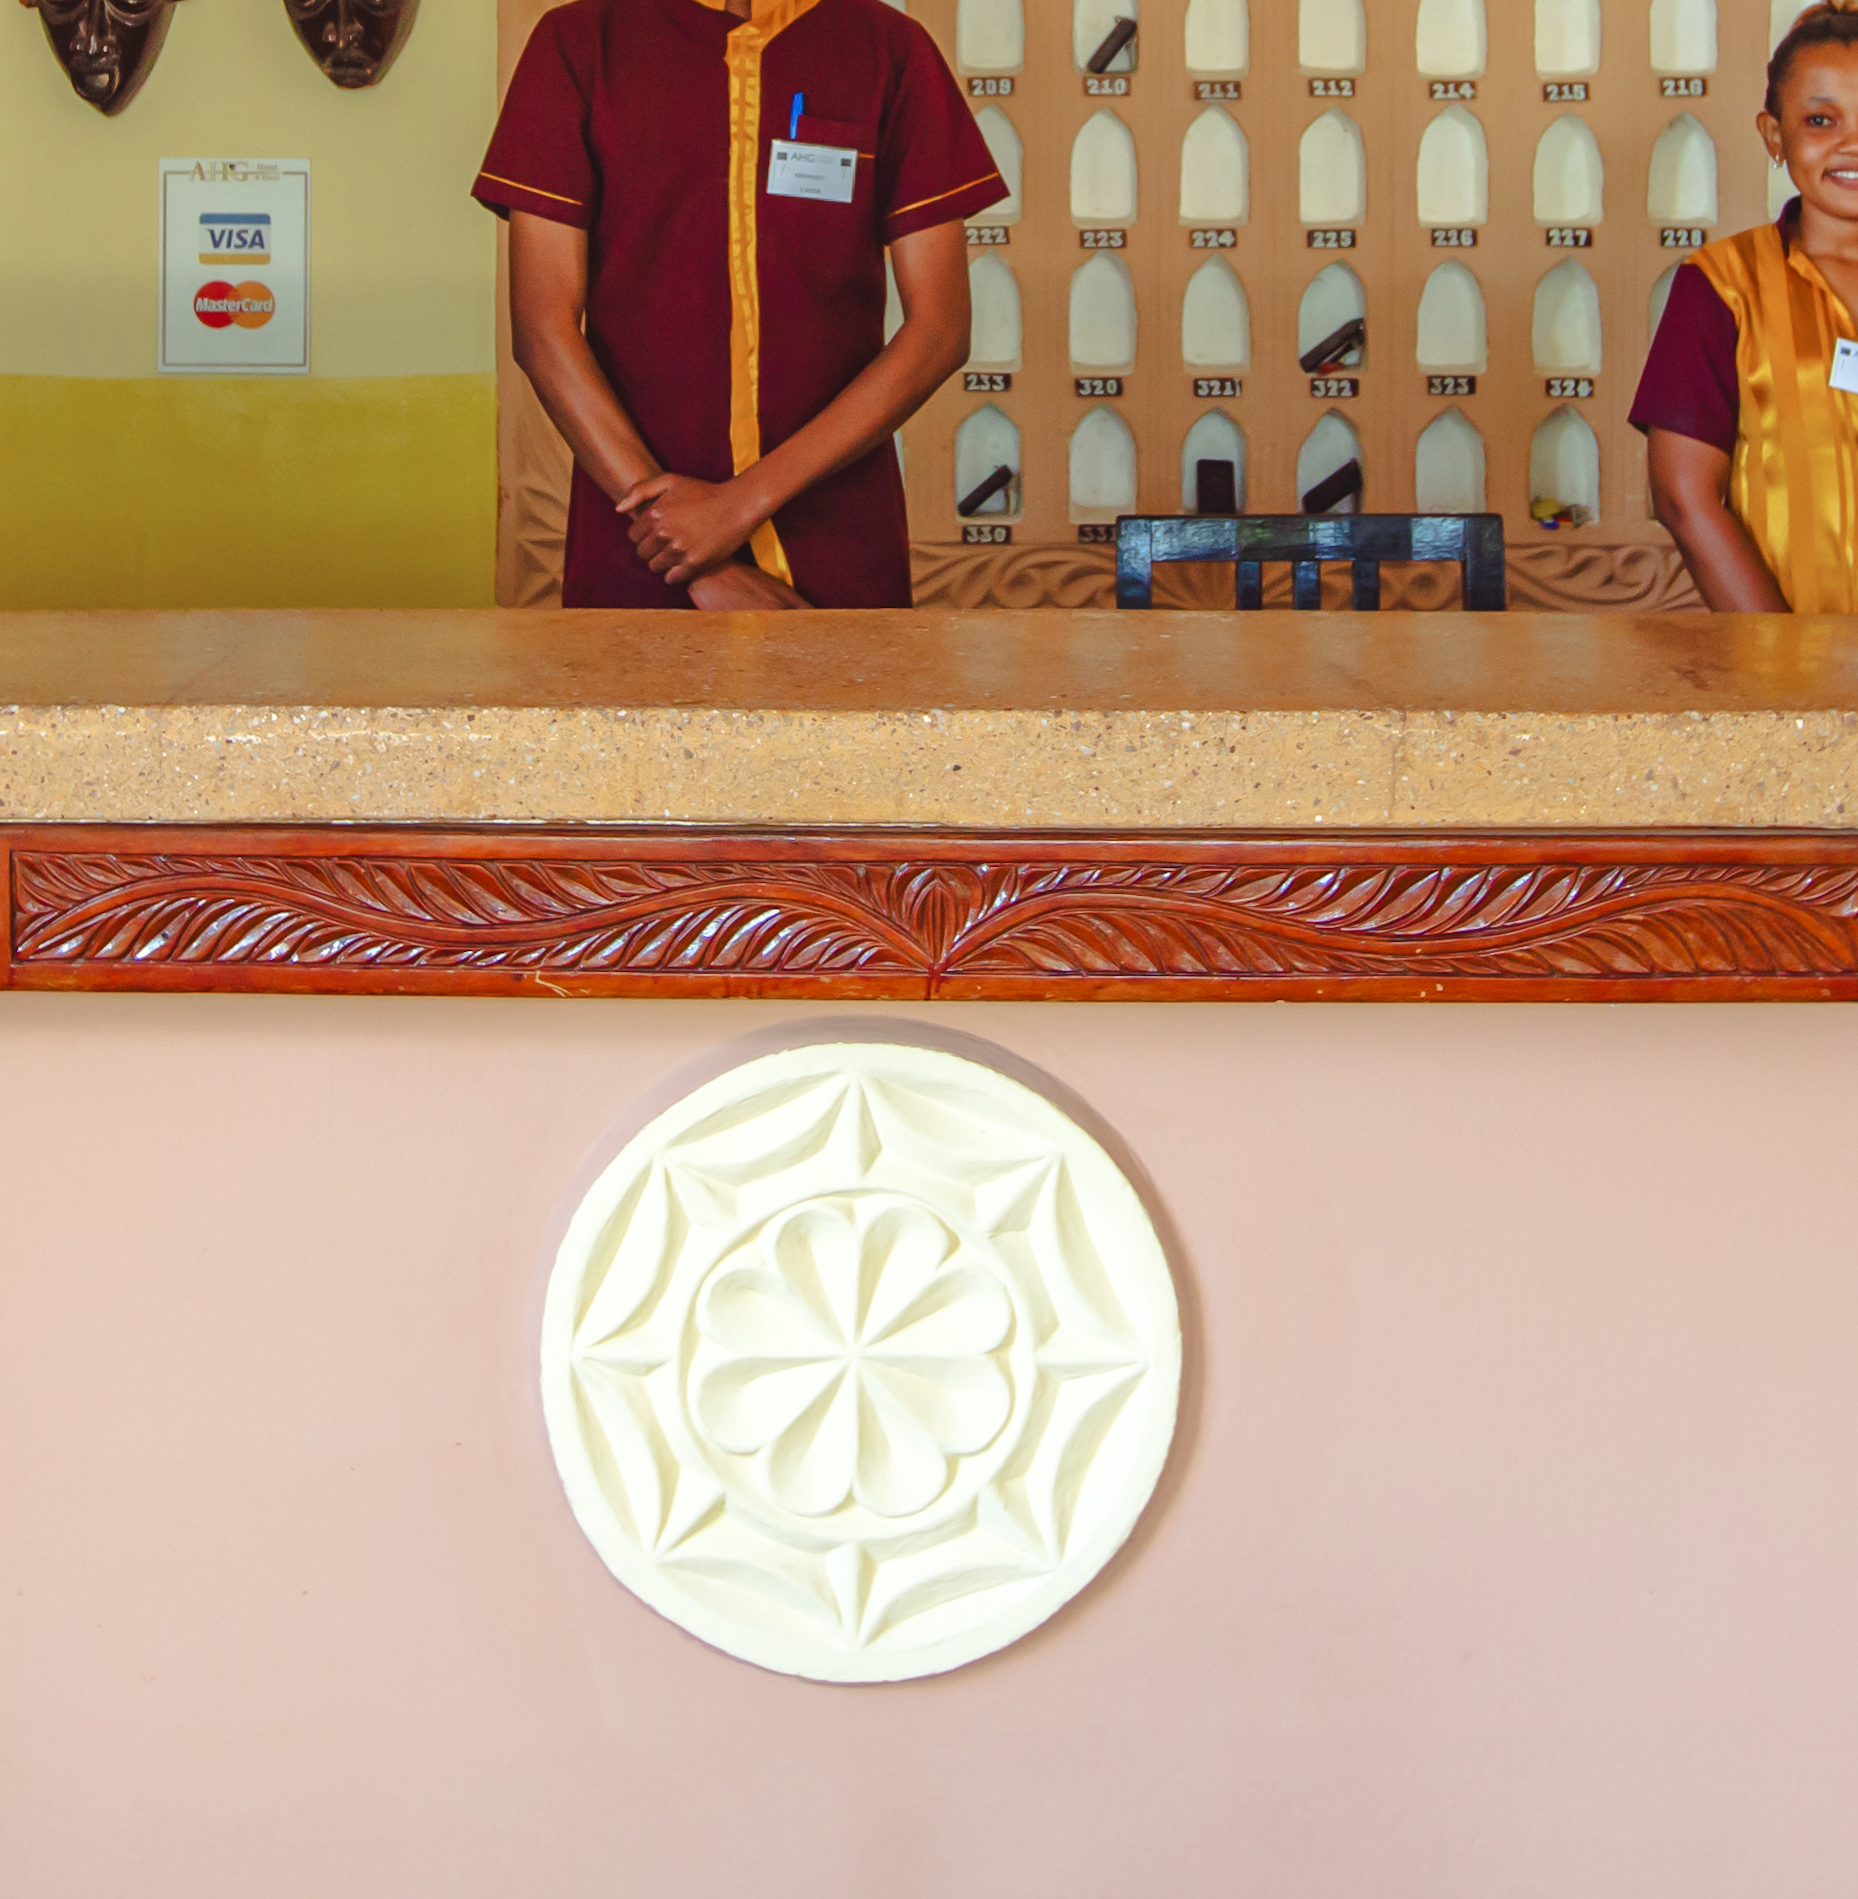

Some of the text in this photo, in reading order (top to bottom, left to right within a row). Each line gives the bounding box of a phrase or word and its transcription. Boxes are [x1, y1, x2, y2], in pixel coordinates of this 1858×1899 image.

[1087, 79, 1126, 94] 210
[1197, 82, 1237, 98] 211
[1313, 81, 1352, 96] 212
[1434, 83, 1474, 99] 214
[1547, 85, 1585, 100] 215
[1664, 79, 1702, 96] 216
[188, 161, 248, 182] AHG
[207, 229, 265, 249] VISA
[967, 228, 1006, 244] 222
[1084, 231, 1122, 247] 223
[1193, 231, 1234, 247] 224
[1313, 232, 1351, 248] 225
[1435, 230, 1473, 246] 226
[1549, 230, 1587, 246] 227
[1665, 230, 1703, 246] 228
[195, 297, 272, 313] MasterCard
[968, 375, 1004, 391] 233
[1080, 380, 1116, 395] 320
[1314, 380, 1352, 397] 322
[1432, 378, 1468, 394] 323
[967, 526, 1007, 542] 330
